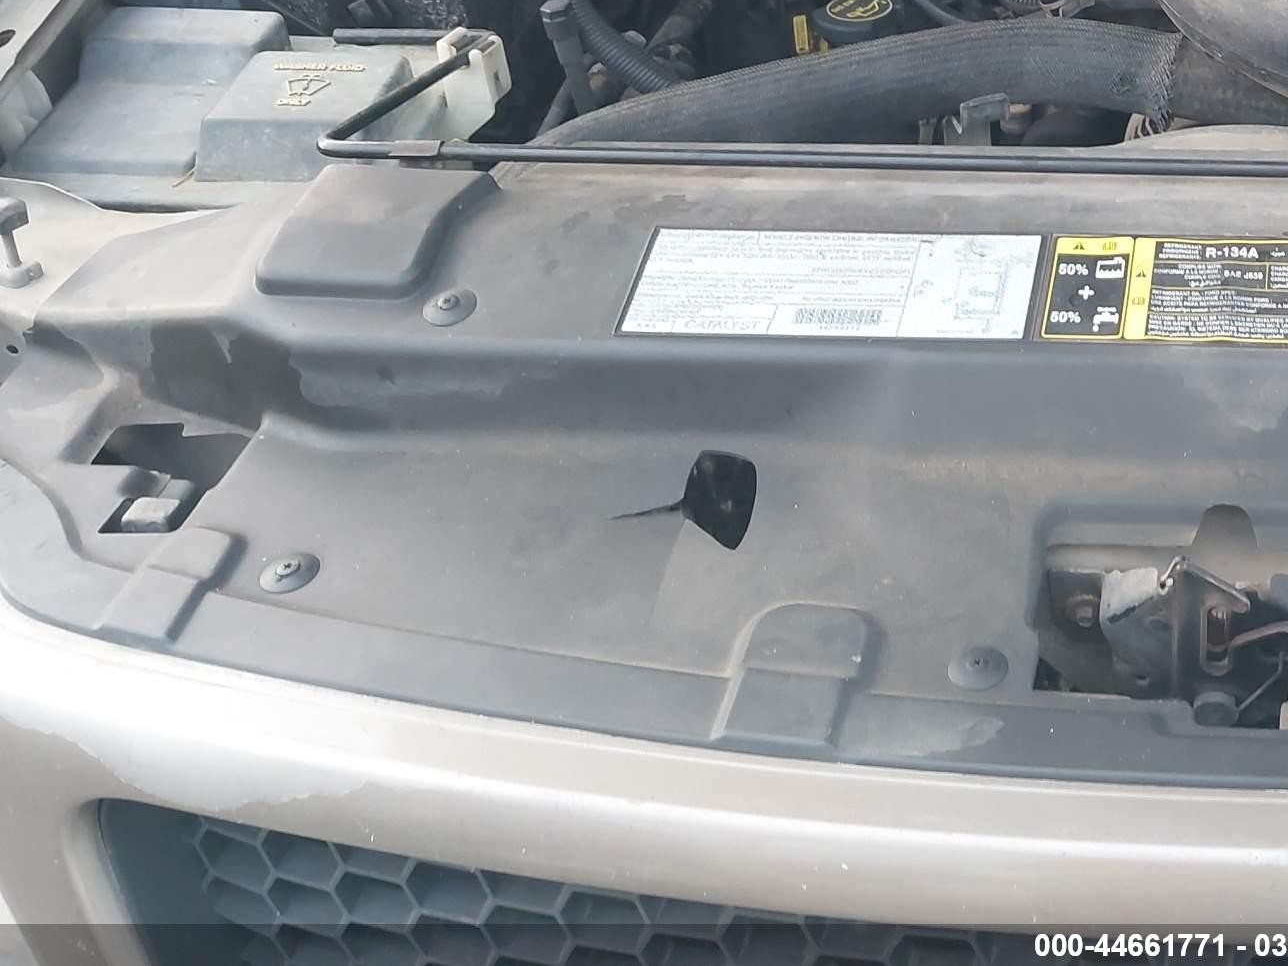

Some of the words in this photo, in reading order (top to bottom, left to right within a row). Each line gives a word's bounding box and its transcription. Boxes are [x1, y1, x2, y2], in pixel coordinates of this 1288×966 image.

[329, 63, 367, 72] FLUID
[275, 96, 311, 106] ONLY
[1205, 246, 1259, 259] R-134A
[1058, 263, 1089, 276] 50%
[1050, 311, 1081, 323] 50%
[683, 318, 759, 331] CATALYST
